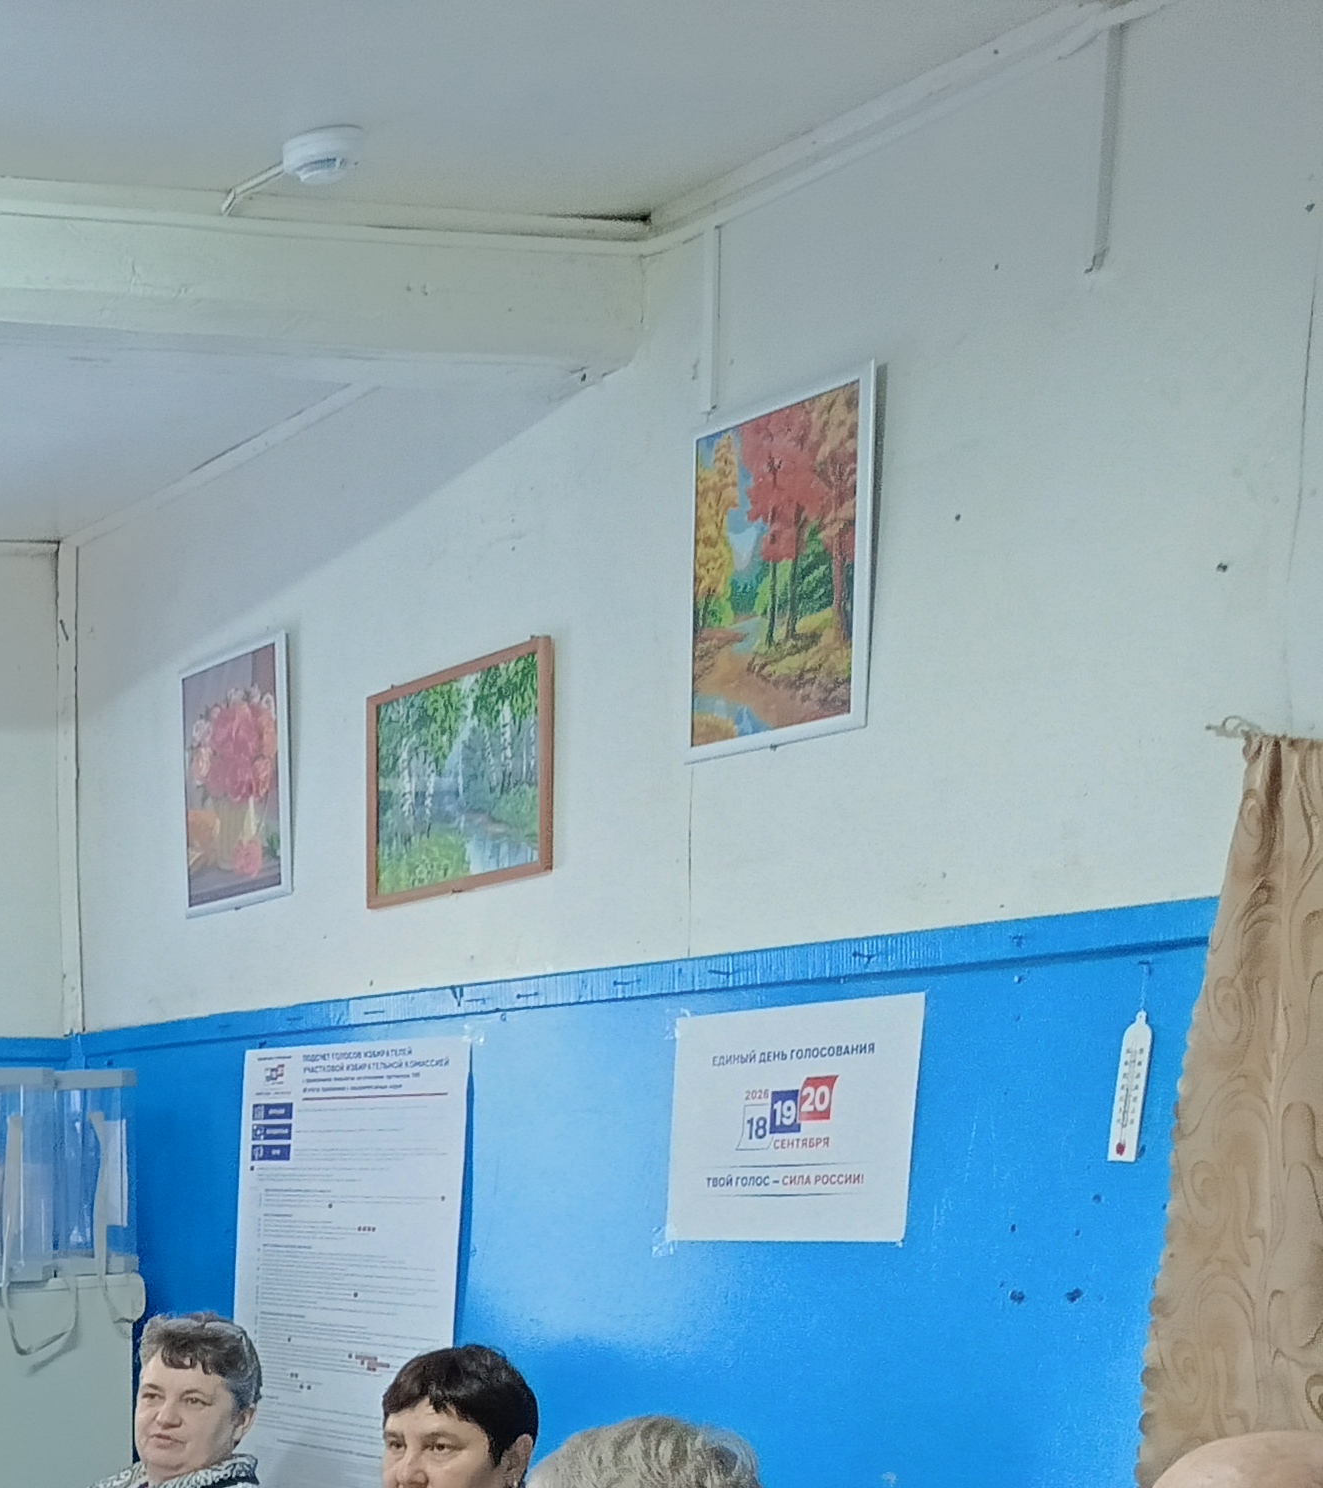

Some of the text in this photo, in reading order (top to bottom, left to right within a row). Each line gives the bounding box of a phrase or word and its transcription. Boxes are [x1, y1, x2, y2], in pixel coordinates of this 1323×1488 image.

[712, 1042, 876, 1067] ЕДИНЫЙ ДЕНЬ ГОЛОСОВАНИЯ
[744, 1088, 769, 1101] 2026
[746, 1085, 830, 1141] 18 19 20
[773, 1136, 830, 1150] СЕНТЯБРЯ
[706, 1174, 733, 1189] ТВОЙ
[735, 1175, 770, 1187] ГОЛОС
[781, 1175, 812, 1187] СИЛА
[814, 1173, 864, 1186] РОССИИ!
